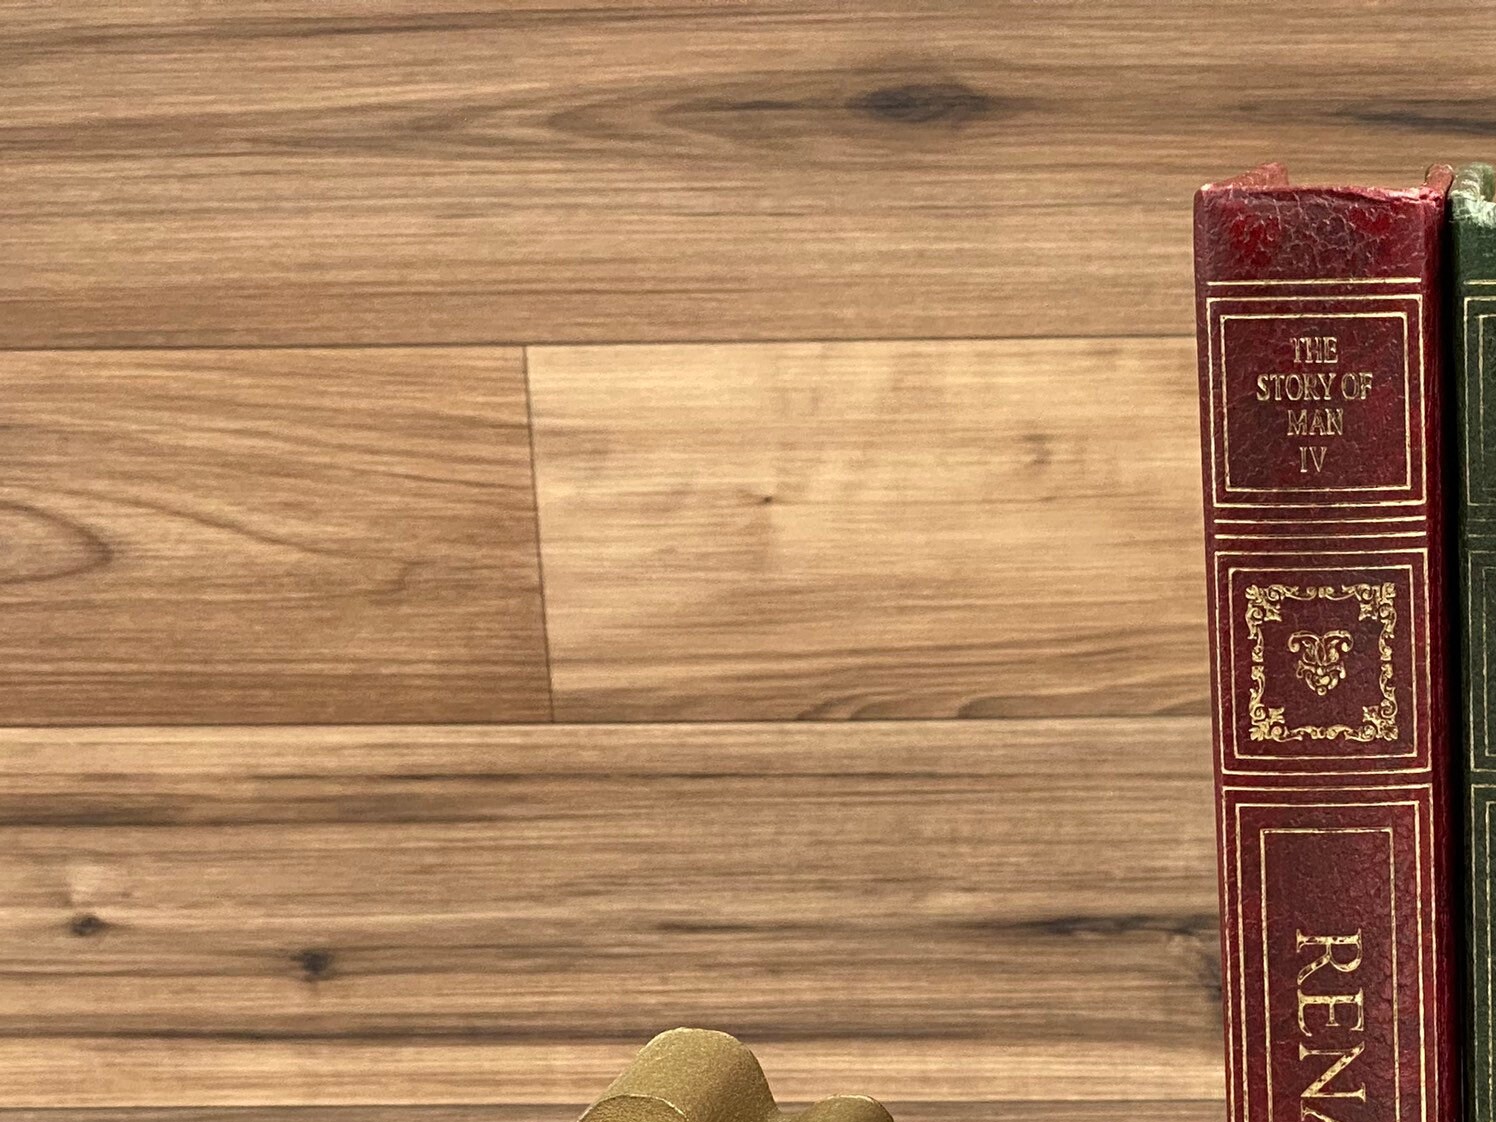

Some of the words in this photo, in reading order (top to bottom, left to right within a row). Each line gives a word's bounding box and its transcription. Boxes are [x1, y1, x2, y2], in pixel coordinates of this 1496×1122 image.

[1290, 336, 1338, 363] THE
[1256, 372, 1337, 401] STORY
[1341, 372, 1374, 401] OF
[1287, 408, 1344, 436] MAN
[1299, 446, 1328, 473] IV
